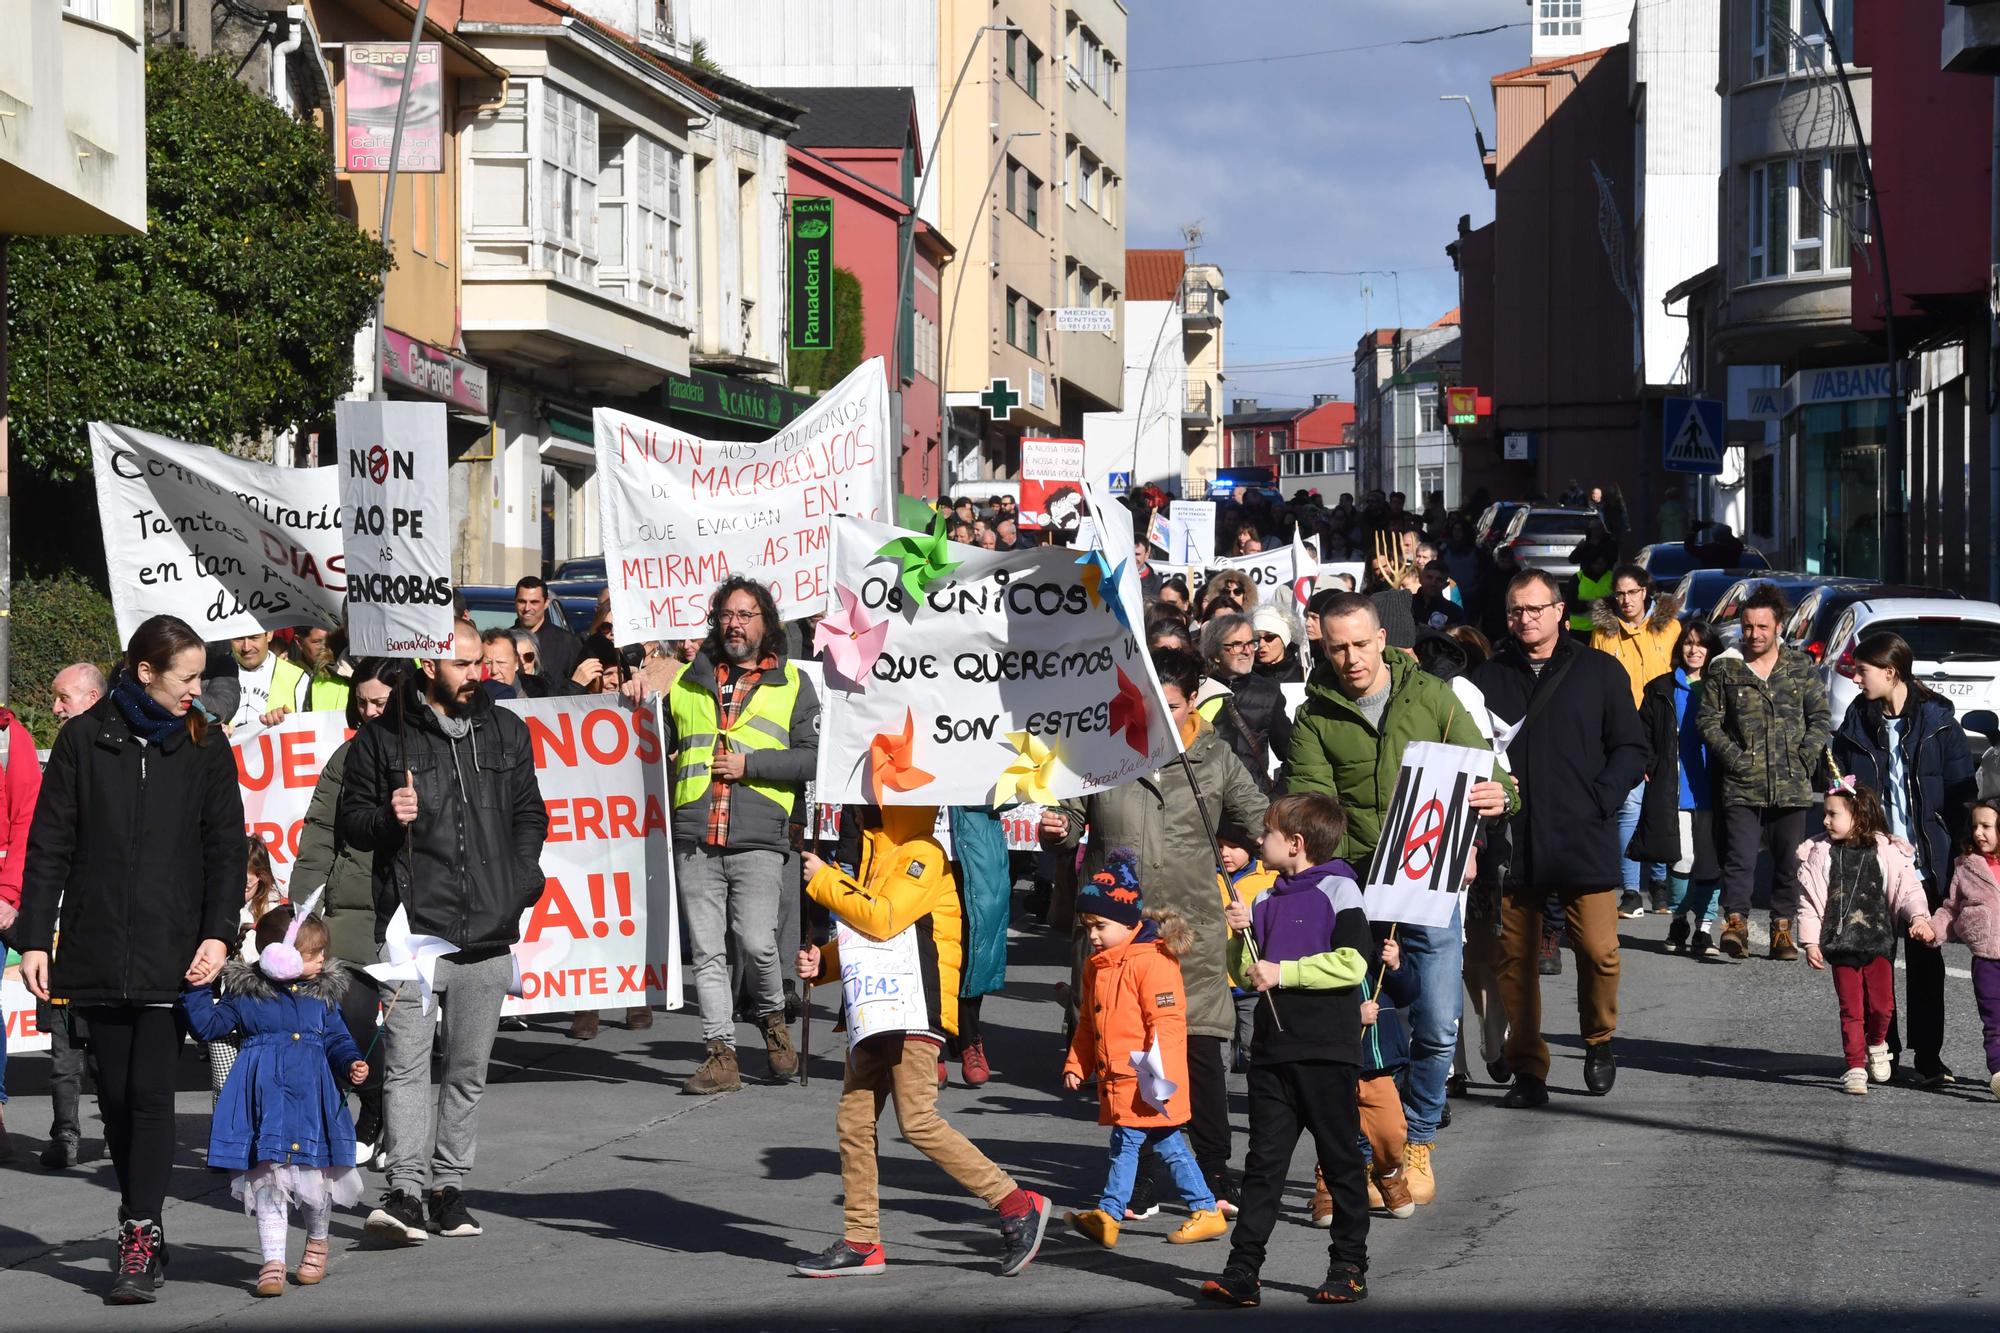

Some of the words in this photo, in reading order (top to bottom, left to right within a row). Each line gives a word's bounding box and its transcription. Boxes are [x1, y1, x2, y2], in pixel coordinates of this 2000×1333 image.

[350, 48, 438, 64] Carael
[804, 249, 820, 344] Panadería
[408, 343, 454, 397] Caravel
[620, 422, 703, 466] NUN
[718, 441, 757, 460] AOS
[651, 483, 671, 499] DE
[354, 505, 384, 537] AO
[392, 507, 423, 539] PE
[638, 523, 677, 542] QUE
[139, 562, 182, 585] en
[188, 543, 246, 579] tan
[379, 547, 394, 562] AS
[621, 550, 730, 591] MEIRAMA
[346, 573, 453, 606] ENCROBAS
[861, 577, 903, 614] Os
[872, 651, 937, 683] QUE
[953, 646, 1114, 683] QUEREMOS
[1949, 684, 1974, 695] GZP
[932, 714, 999, 744] SON
[514, 967, 608, 1001] ONTE
